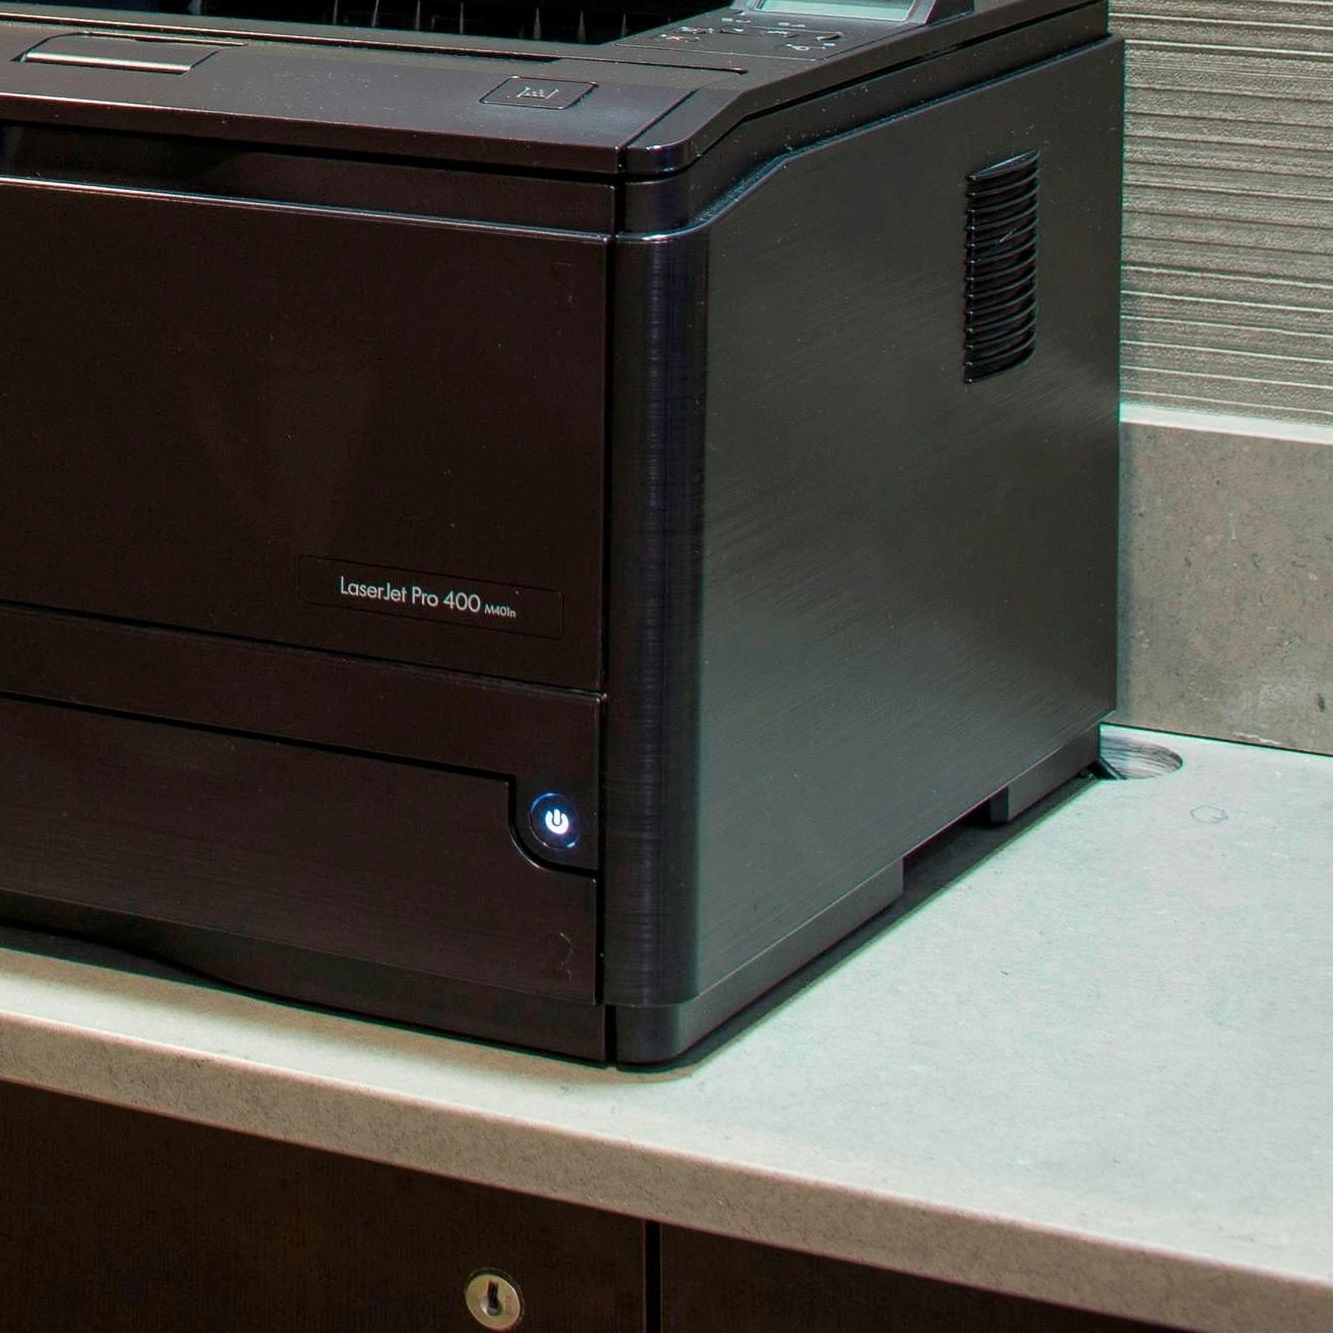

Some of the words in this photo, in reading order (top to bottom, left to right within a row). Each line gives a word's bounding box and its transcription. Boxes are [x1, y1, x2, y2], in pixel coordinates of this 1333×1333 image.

[340, 575, 406, 603] LaserJet
[412, 586, 439, 608] Pro
[443, 590, 481, 614] 400
